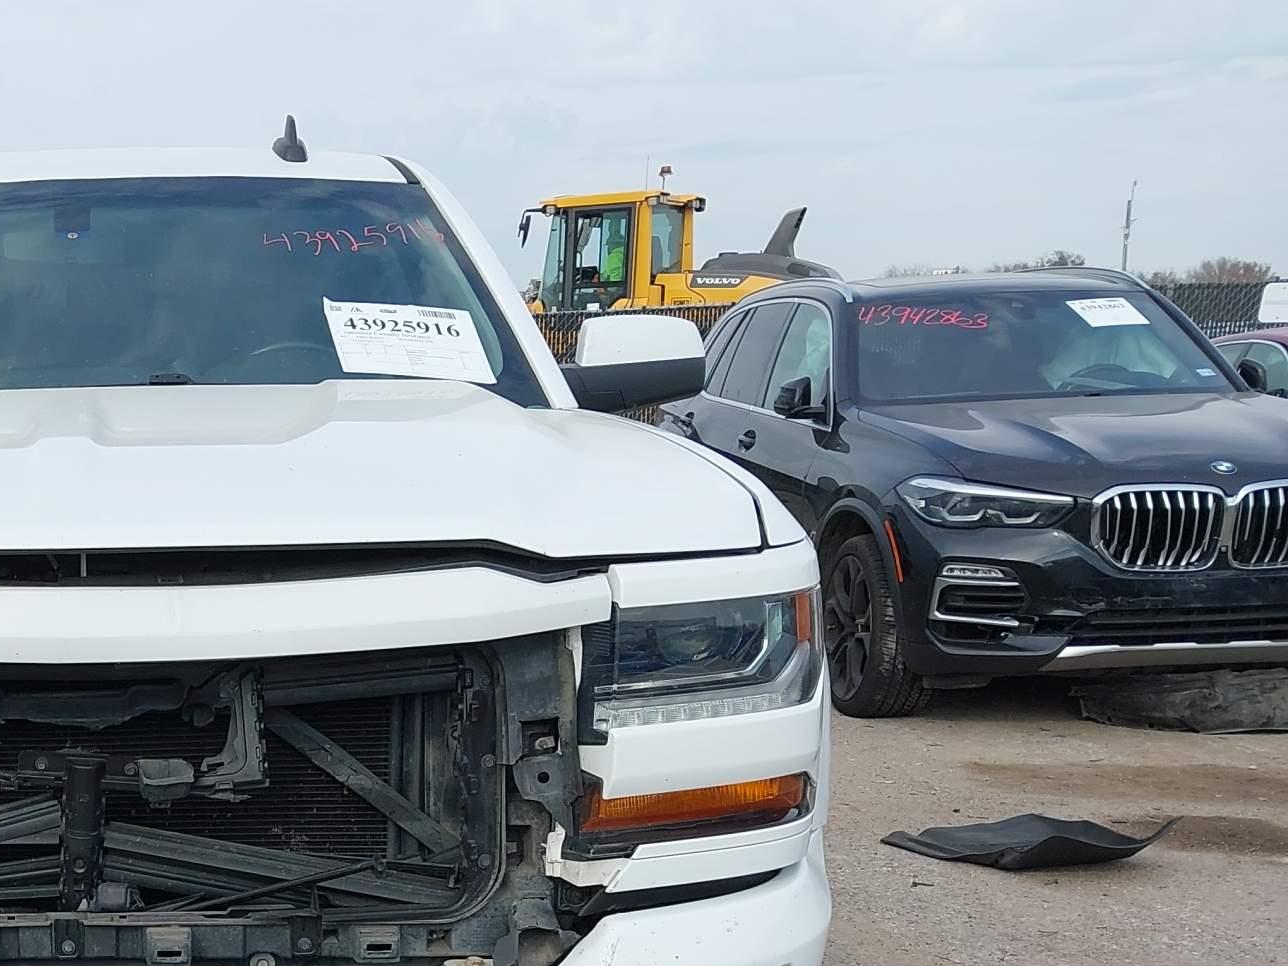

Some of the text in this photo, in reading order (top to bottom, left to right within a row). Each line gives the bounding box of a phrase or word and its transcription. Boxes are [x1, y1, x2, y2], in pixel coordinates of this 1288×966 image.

[696, 277, 741, 285] VOLVO
[343, 316, 461, 338] 43925916
[858, 304, 988, 329] 43942863
